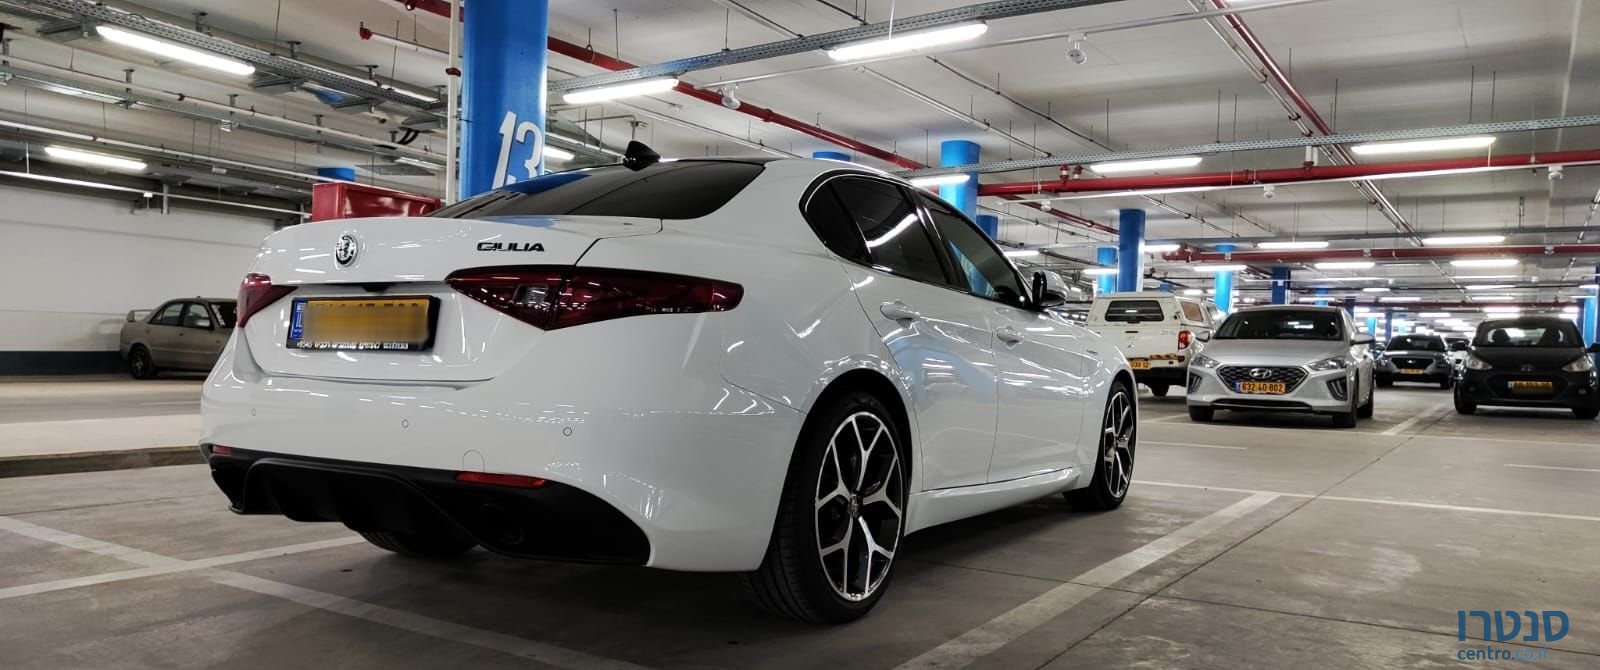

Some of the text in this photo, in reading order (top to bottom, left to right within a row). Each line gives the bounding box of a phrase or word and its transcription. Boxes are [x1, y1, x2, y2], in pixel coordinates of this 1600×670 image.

[492, 111, 543, 190] 13
[477, 242, 545, 252] GIULIA
[1242, 382, 1256, 391] 632
[1269, 383, 1283, 392] 802
